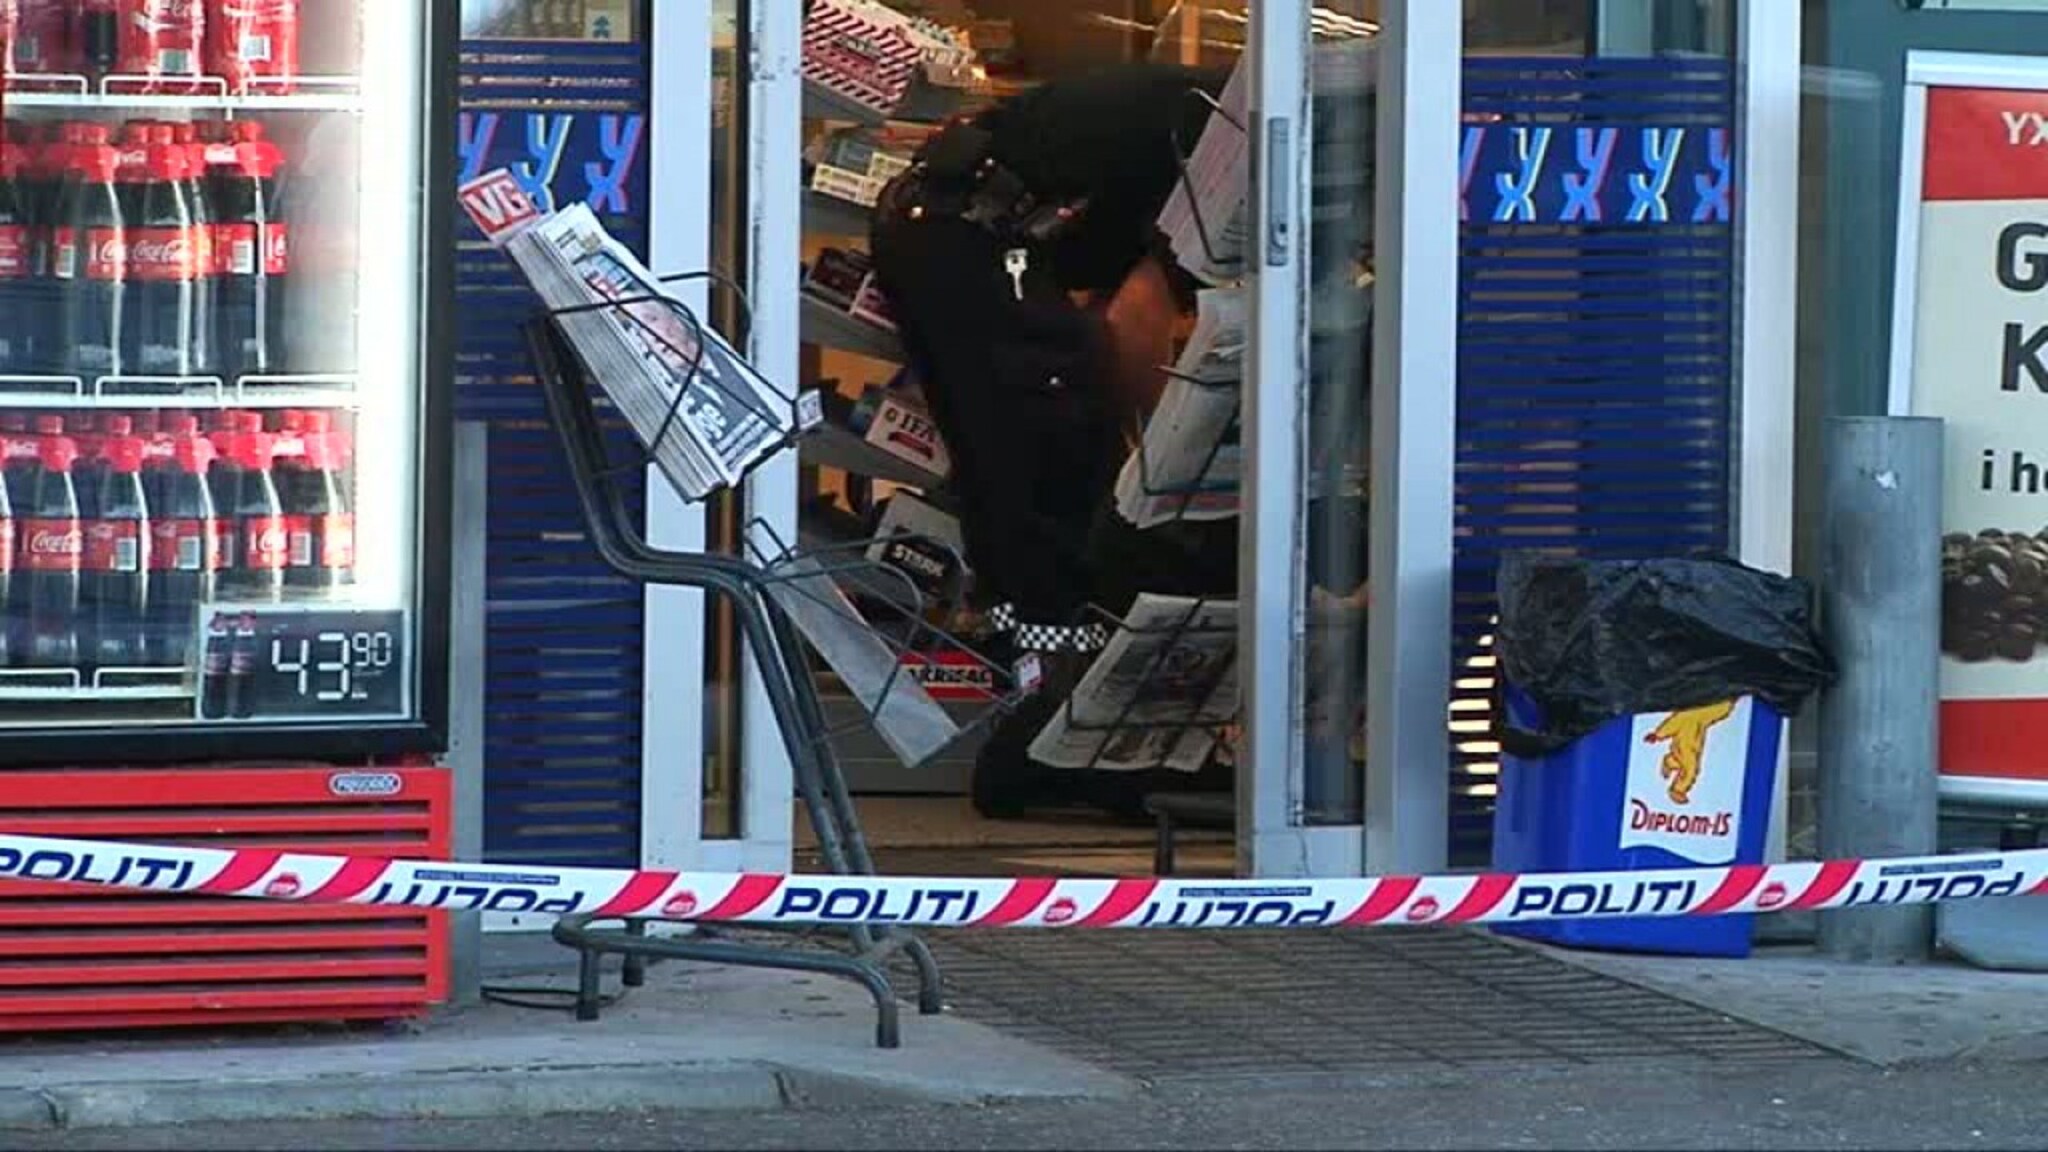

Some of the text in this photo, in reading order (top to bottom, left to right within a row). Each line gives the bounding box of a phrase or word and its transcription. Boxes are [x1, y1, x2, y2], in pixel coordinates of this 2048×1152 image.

[463, 180, 529, 226] VG
[1982, 449, 2048, 494] i h
[774, 886, 981, 922] POLITI
[1508, 880, 1697, 917] POLITI
